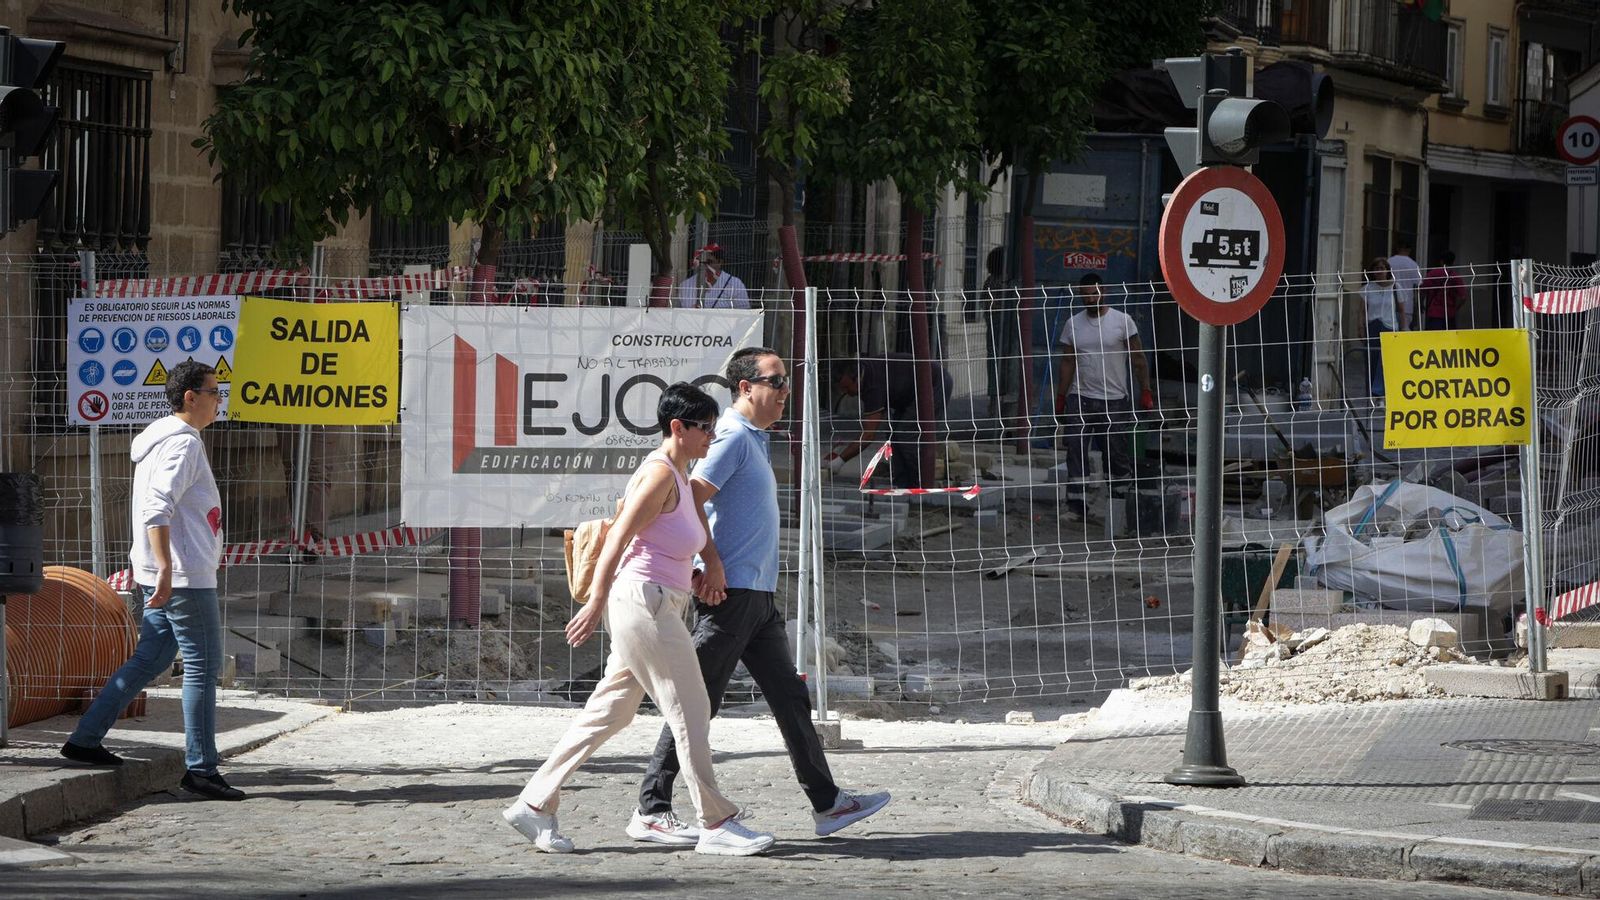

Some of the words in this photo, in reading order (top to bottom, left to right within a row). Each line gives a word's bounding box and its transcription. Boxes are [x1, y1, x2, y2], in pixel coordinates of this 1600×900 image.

[1568, 132, 1594, 148] 10
[1218, 236, 1251, 256] 5,5t
[84, 303, 95, 312] ES
[96, 302, 149, 312] OBLIGATORIO
[151, 301, 180, 311] SEGUIR
[181, 301, 196, 310] LAS
[197, 300, 231, 309] NORMAS
[78, 314, 90, 323] DE
[91, 312, 143, 322] PREVENCION
[144, 312, 155, 321] DE
[156, 312, 191, 321] RIESGOS
[192, 310, 236, 320] LABORALES
[270, 316, 371, 343] SALIDA
[611, 334, 733, 348] CONSTRUCTORA
[300, 352, 338, 376] DE
[577, 356, 598, 370] NO
[1409, 347, 1500, 370] CAMINO
[112, 392, 124, 401] NO
[125, 392, 136, 401] SE
[137, 391, 168, 400] PERMIT
[241, 381, 388, 408] CAMIONES
[1401, 377, 1511, 400] CORTADO
[112, 401, 134, 411] OBRA
[138, 401, 149, 410] DE
[151, 401, 171, 410] PERS
[112, 411, 124, 421] NO
[1390, 409, 1437, 430] POR
[1444, 406, 1526, 428] OBRAS
[481, 452, 593, 469] EDIFICACIÓN
